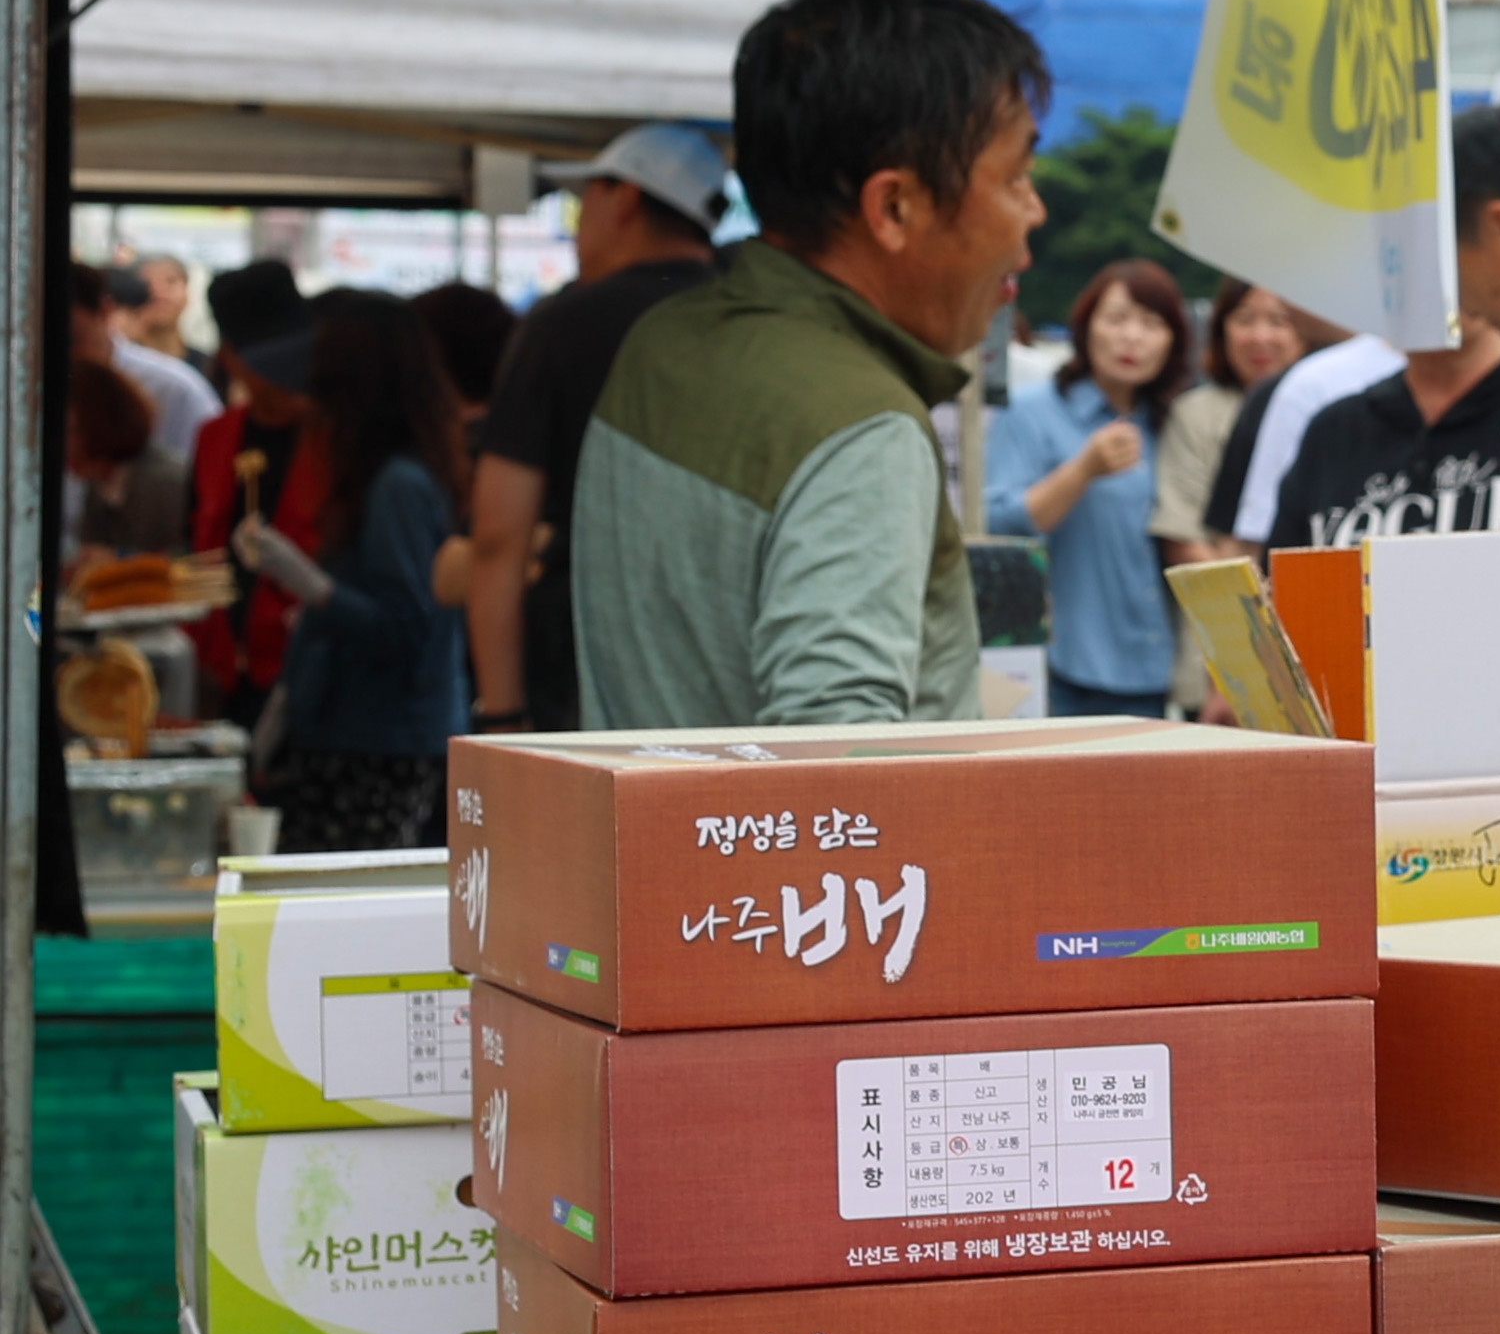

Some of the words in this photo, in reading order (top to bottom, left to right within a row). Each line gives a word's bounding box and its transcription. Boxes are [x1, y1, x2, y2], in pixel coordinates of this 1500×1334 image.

[695, 810, 798, 856] 정성을
[812, 806, 881, 851] 담은
[1052, 936, 1099, 957] NH
[978, 1060, 991, 1073] 배
[973, 1084, 998, 1100] 신고
[1070, 1092, 1147, 1107] 010-9624-9203
[960, 1112, 984, 1127] 전남
[988, 1110, 1011, 1125] 나주
[861, 1087, 883, 1189] 표시사항
[1104, 1157, 1135, 1191] 12
[1149, 1160, 1161, 1176] 개
[965, 1190, 994, 1205] 202
[1003, 1189, 1017, 1204] 년
[845, 1247, 901, 1268] 신선도
[904, 1243, 958, 1264] 유지를
[963, 1238, 1000, 1259] 위해
[1004, 1229, 1093, 1258] 냉장보관
[1096, 1228, 1172, 1251] 하십시오.
[329, 1269, 488, 1294] Shinemuscat
